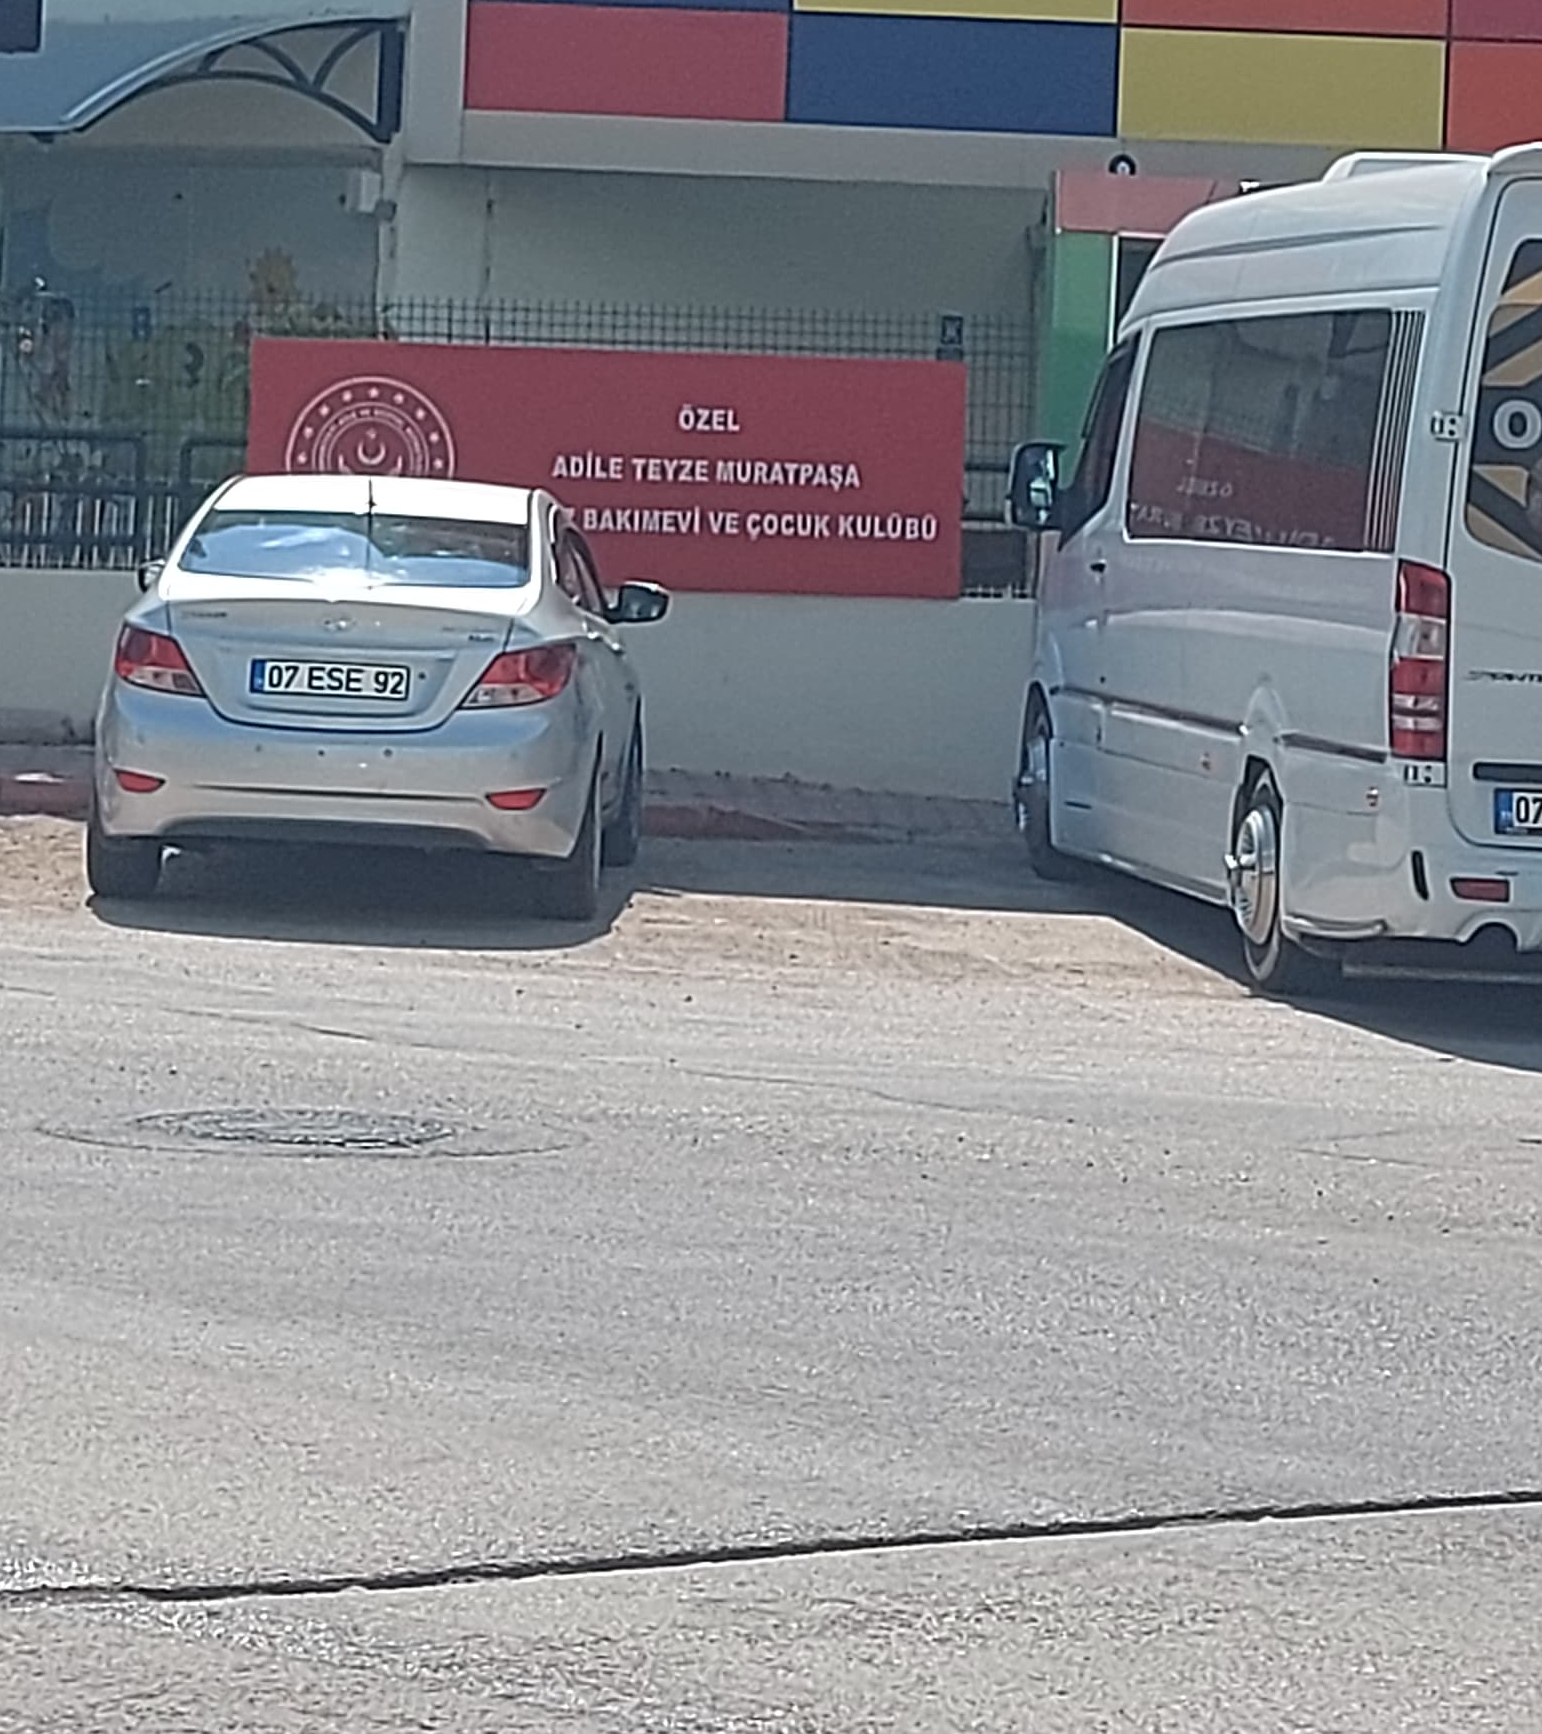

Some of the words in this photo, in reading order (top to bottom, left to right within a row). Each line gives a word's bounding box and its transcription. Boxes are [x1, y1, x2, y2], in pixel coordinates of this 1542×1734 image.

[678, 404, 740, 431] ÖZEL
[551, 450, 624, 480] ADİLE
[631, 457, 709, 482] TEYZE
[715, 459, 861, 492] MURATPAŞA
[582, 506, 701, 534] BAKIMEVİ
[708, 510, 740, 534] VE
[746, 513, 831, 542] ÇOCUK
[838, 512, 938, 541] KULÜBÜ
[268, 665, 300, 689] 07
[307, 666, 365, 693] ESE
[373, 670, 405, 695] 92
